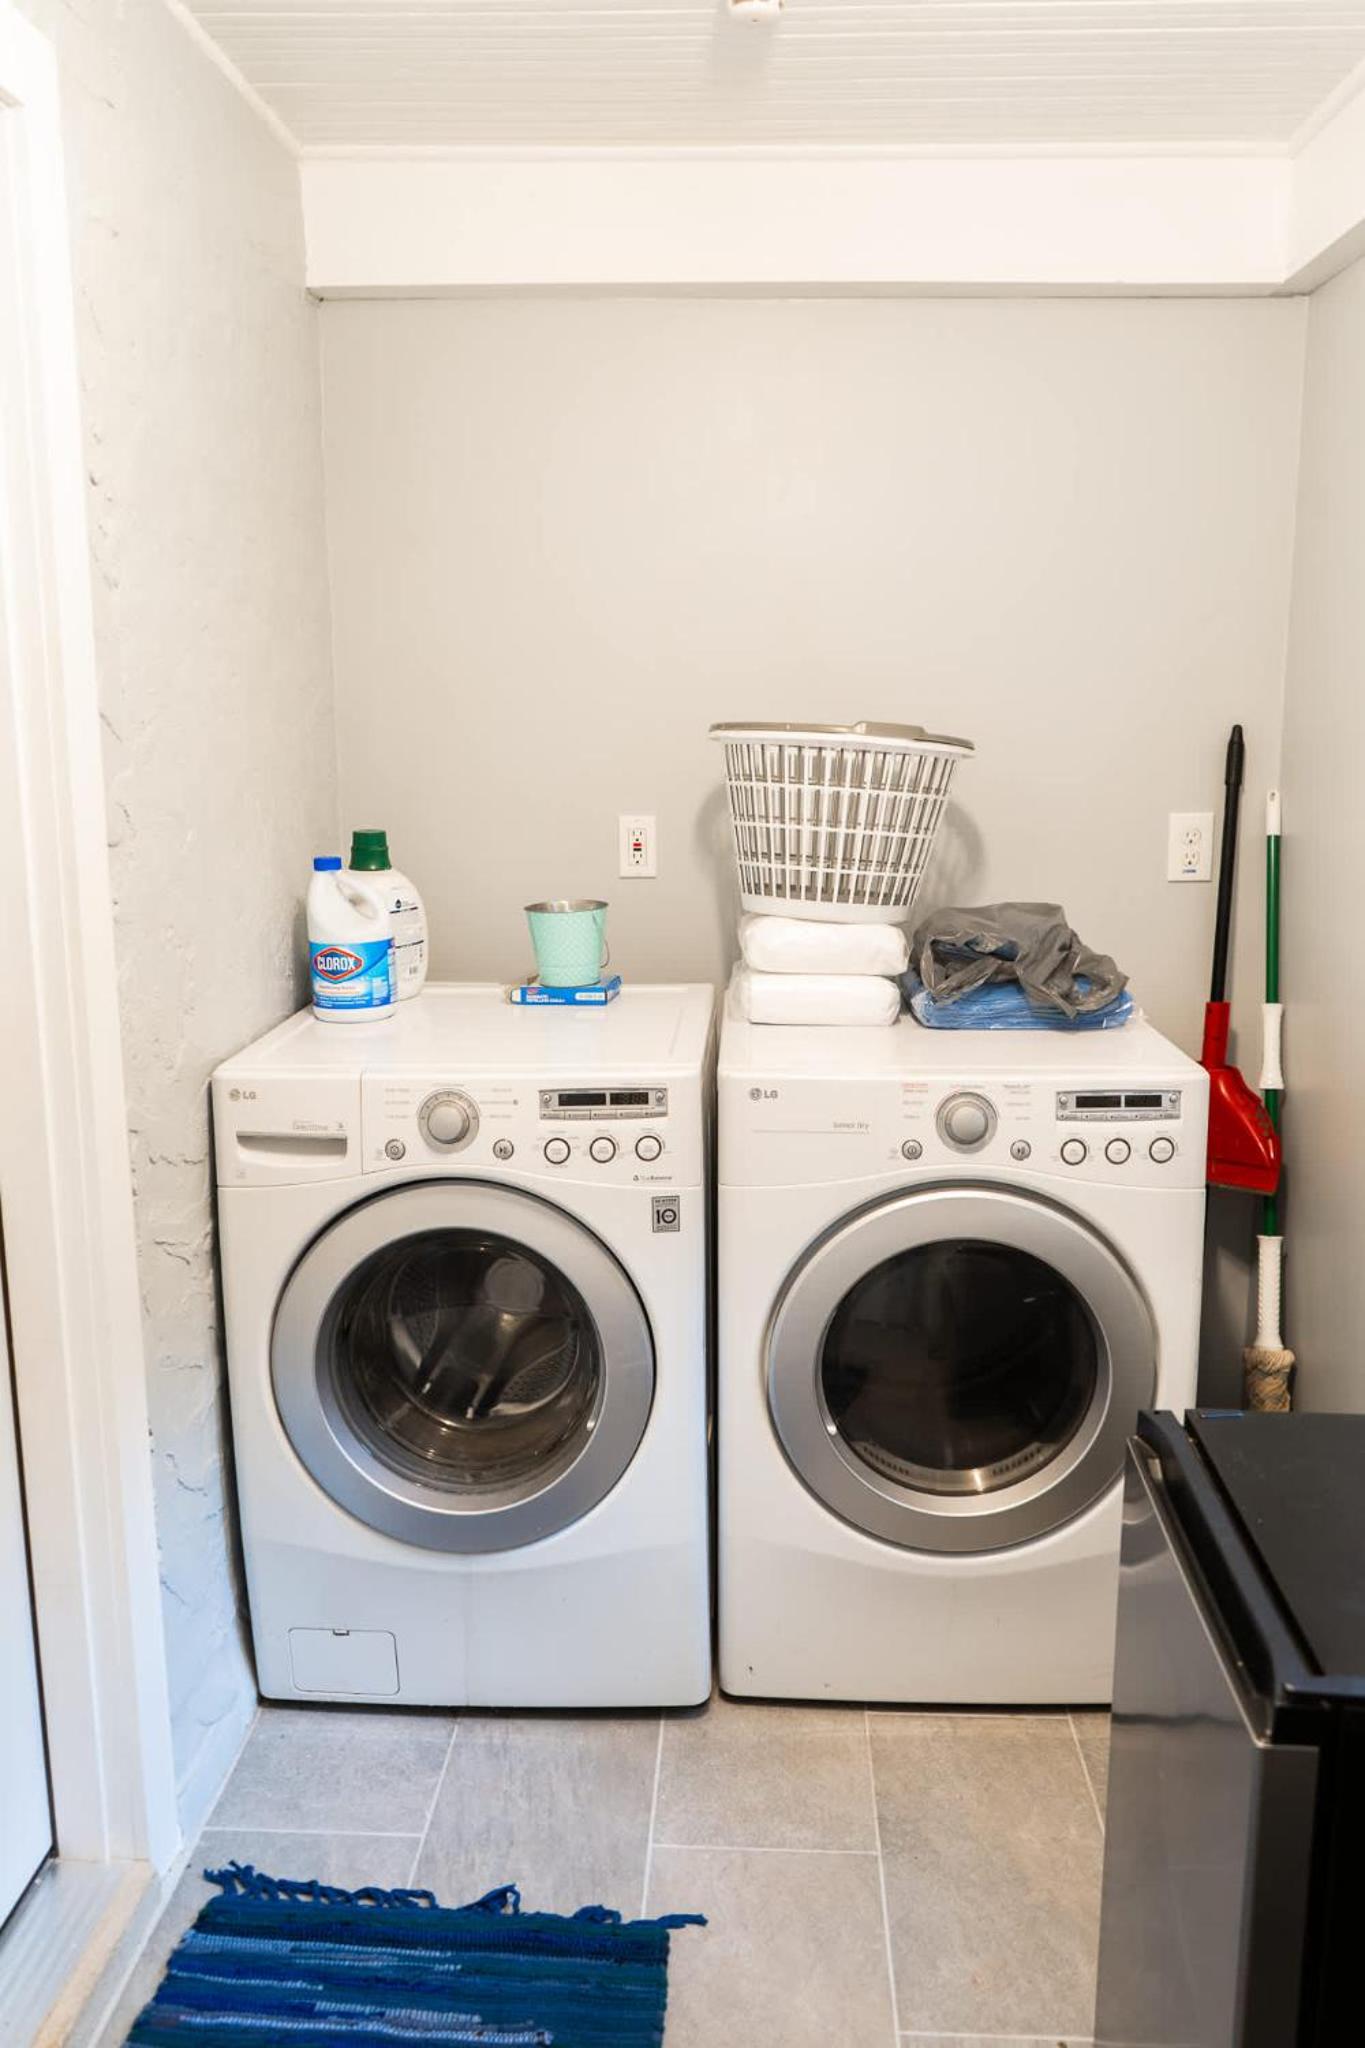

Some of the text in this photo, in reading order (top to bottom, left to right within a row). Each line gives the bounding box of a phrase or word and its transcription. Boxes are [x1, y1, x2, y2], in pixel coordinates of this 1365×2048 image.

[317, 956, 356, 971] CLOROX
[242, 1091, 257, 1100] LG
[764, 1090, 778, 1099] LG
